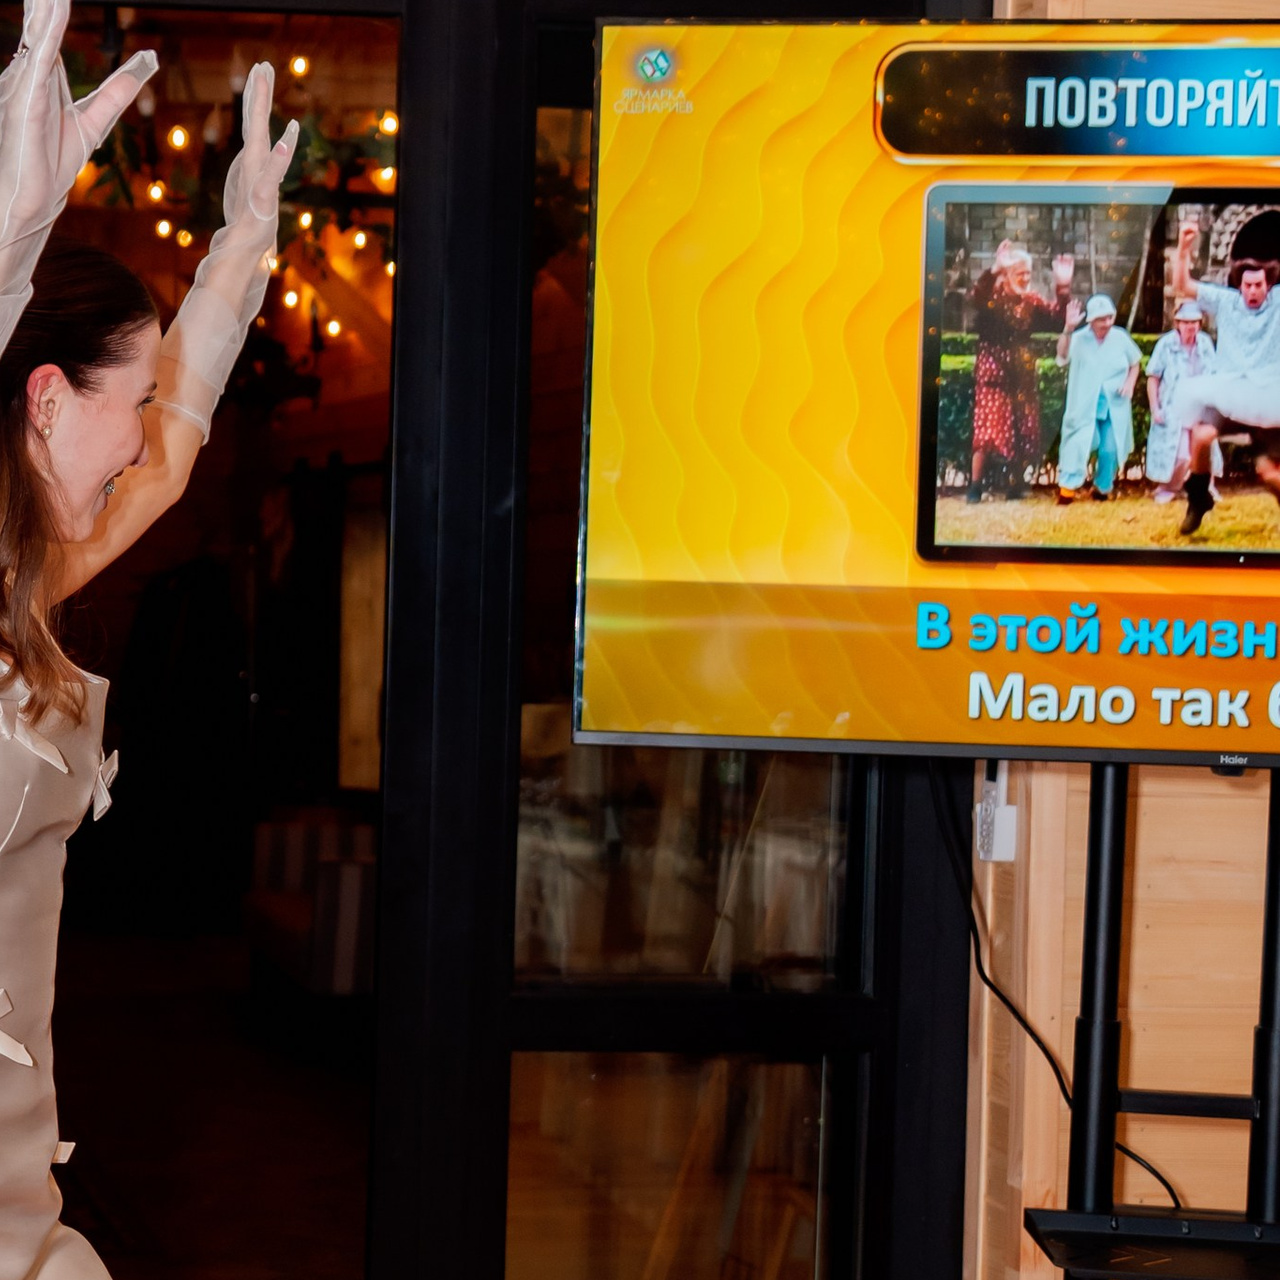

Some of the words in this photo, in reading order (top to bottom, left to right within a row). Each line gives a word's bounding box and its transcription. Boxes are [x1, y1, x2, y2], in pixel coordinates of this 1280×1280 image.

[622, 88, 687, 100] ЯРМАРКА
[613, 100, 694, 114] СЦЕНАРИЕВ
[917, 601, 952, 650] В
[969, 602, 1101, 653] этой
[1118, 617, 1278, 659] жизн
[968, 671, 1137, 725] Мало
[1151, 687, 1252, 729] так
[1220, 754, 1248, 765] Haier
